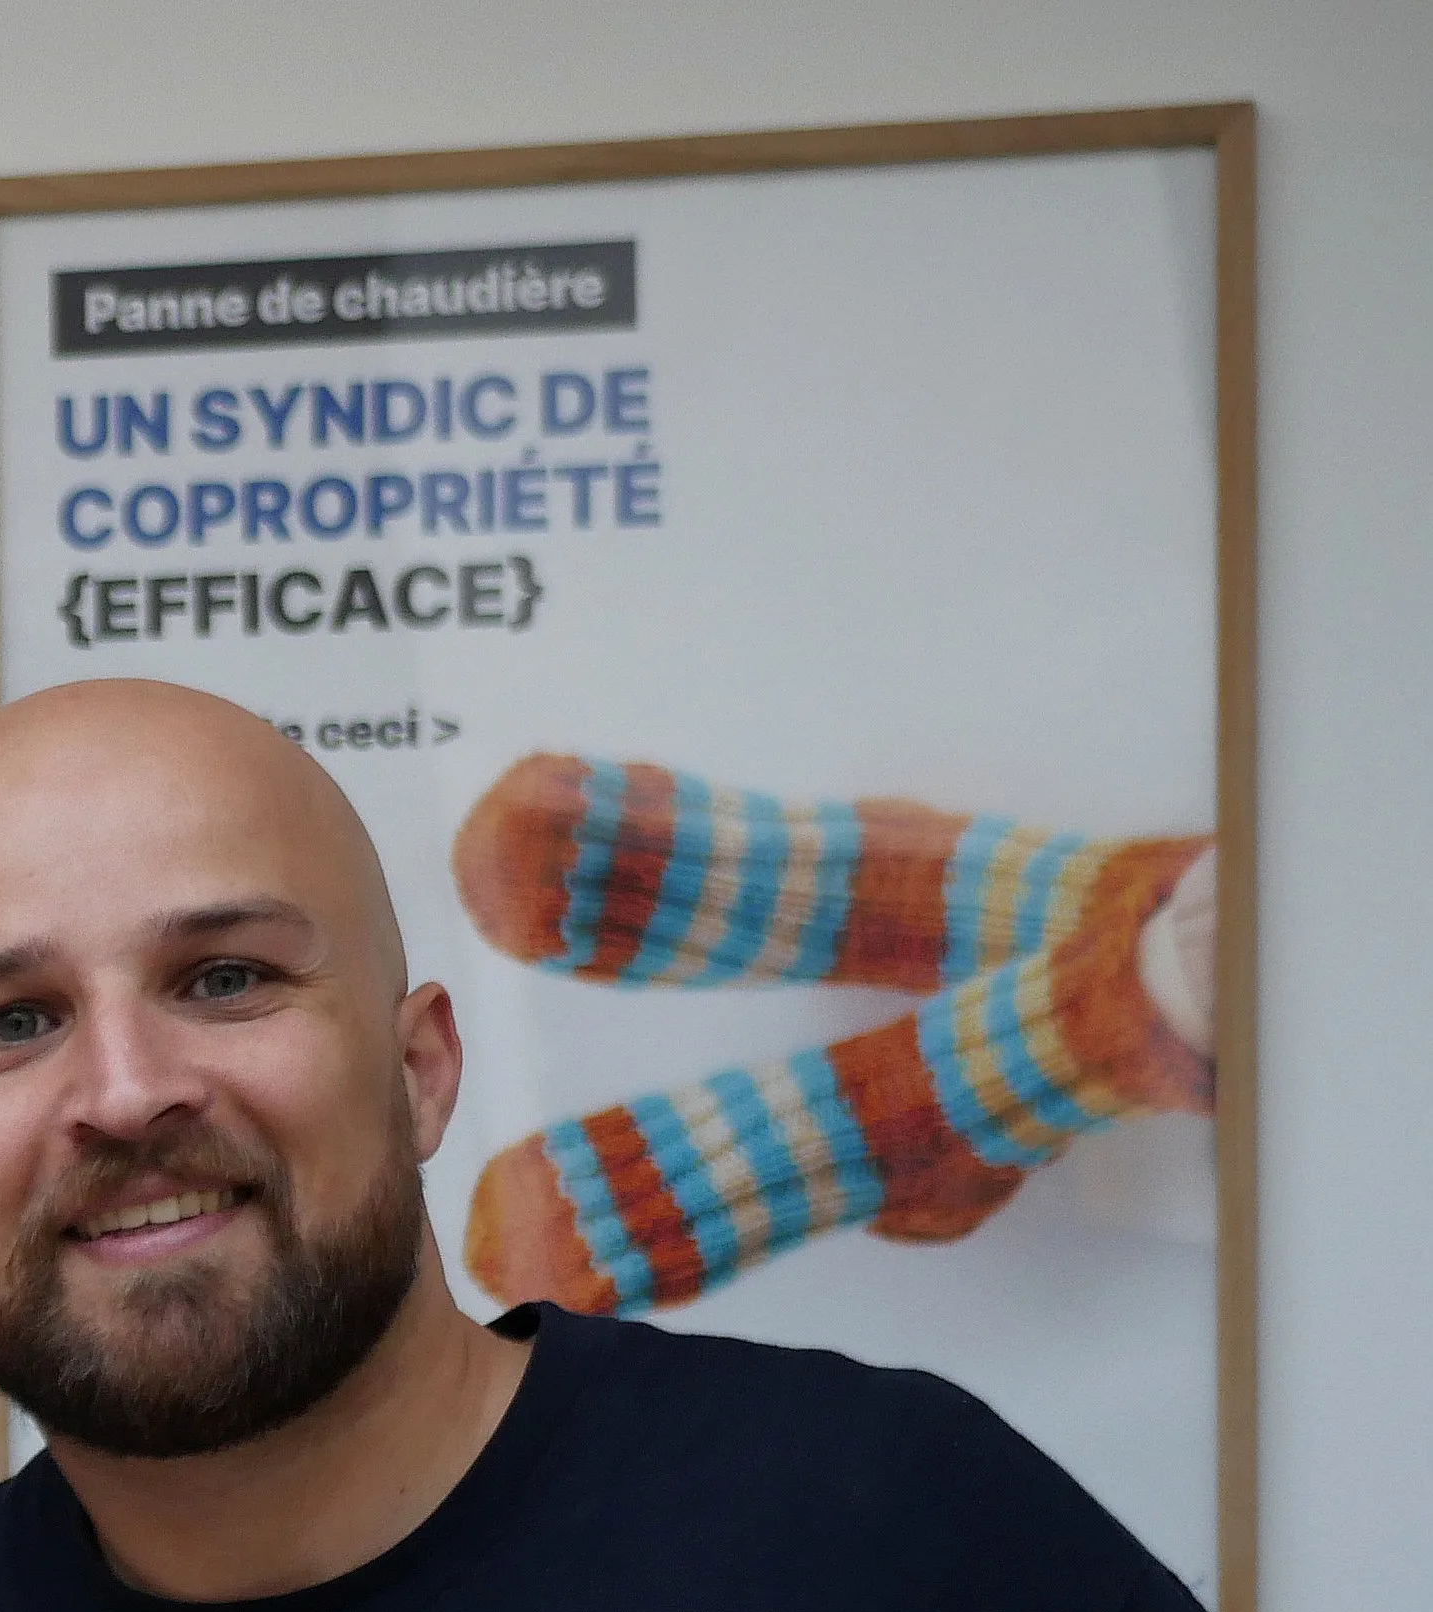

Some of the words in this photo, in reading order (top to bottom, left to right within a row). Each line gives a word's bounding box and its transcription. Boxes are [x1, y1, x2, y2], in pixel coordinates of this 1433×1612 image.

[82, 288, 250, 334] Panne
[257, 279, 325, 325] de
[334, 263, 606, 322] chaudière
[55, 393, 170, 458] UN
[191, 374, 518, 453] SYNDIC
[542, 367, 651, 438] DE
[58, 444, 663, 553] COPROPRIÉTÉ
[57, 555, 544, 648] {EFFICACE}
[316, 706, 420, 752] ceci
